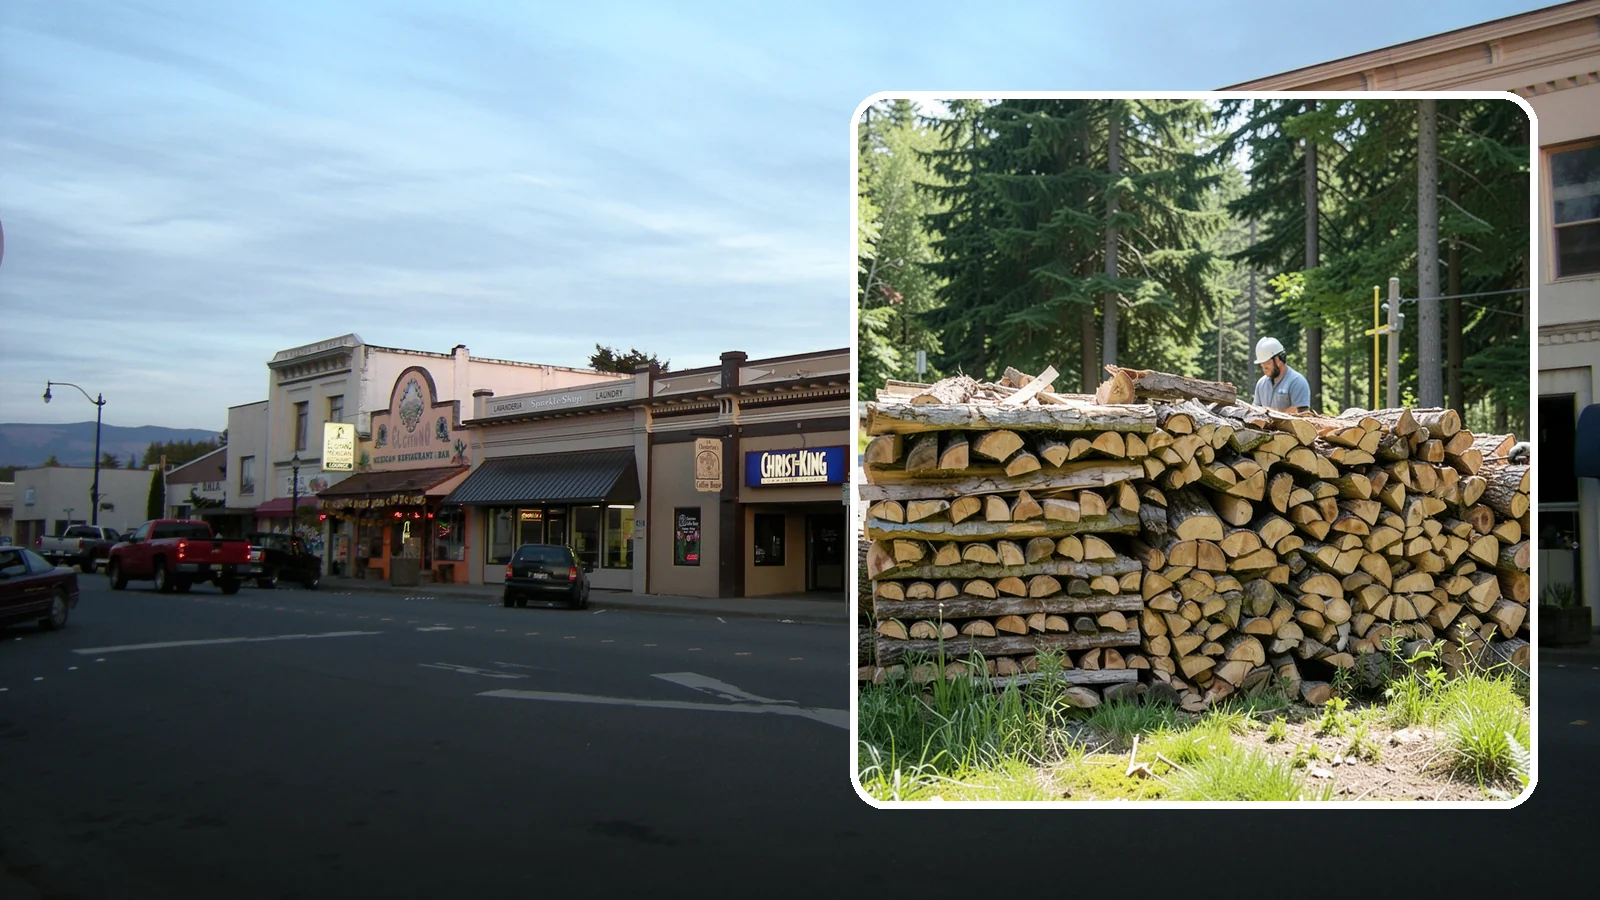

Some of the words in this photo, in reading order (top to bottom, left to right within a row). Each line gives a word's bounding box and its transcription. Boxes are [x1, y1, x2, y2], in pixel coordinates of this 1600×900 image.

[493, 402, 522, 412] LAVANDERIA
[562, 395, 583, 405] Shop
[595, 389, 623, 399] LAUNDRY
[373, 454, 396, 464] MEXICAN
[397, 452, 433, 463] RESTAURANT
[438, 450, 450, 459] BAR
[761, 452, 798, 476] CHRIST
[798, 450, 828, 476] KING
